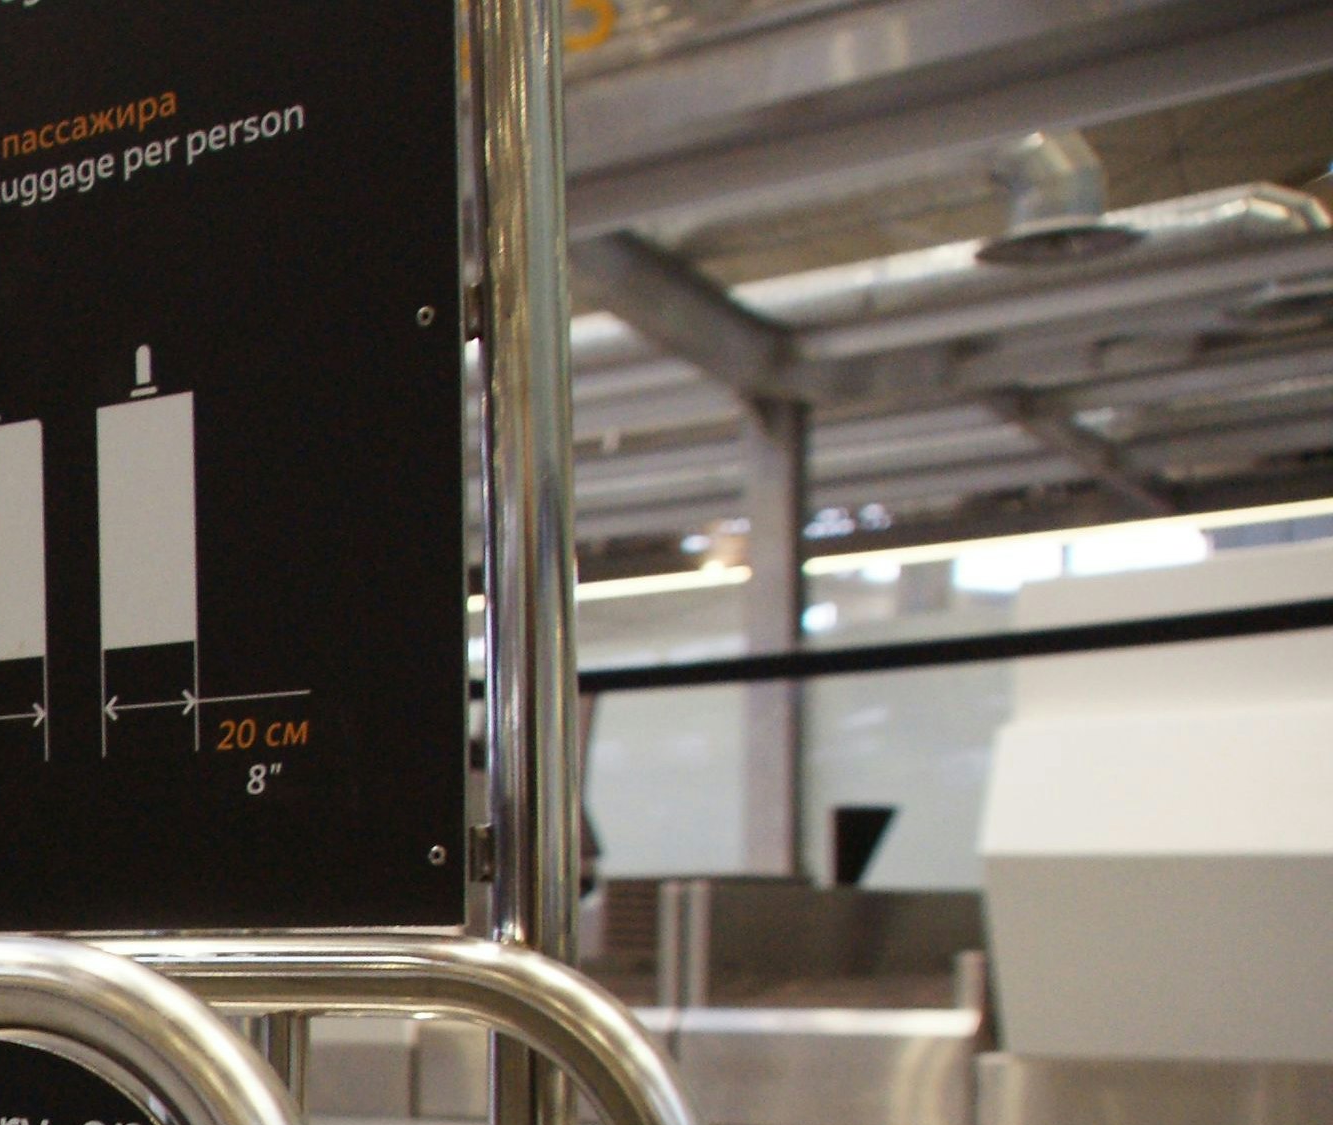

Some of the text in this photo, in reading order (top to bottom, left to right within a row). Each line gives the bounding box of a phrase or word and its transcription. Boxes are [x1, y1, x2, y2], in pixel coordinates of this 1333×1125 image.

[2, 91, 177, 160] пассажира
[123, 136, 179, 180] per
[187, 103, 305, 165] person
[217, 718, 309, 751] 20 см
